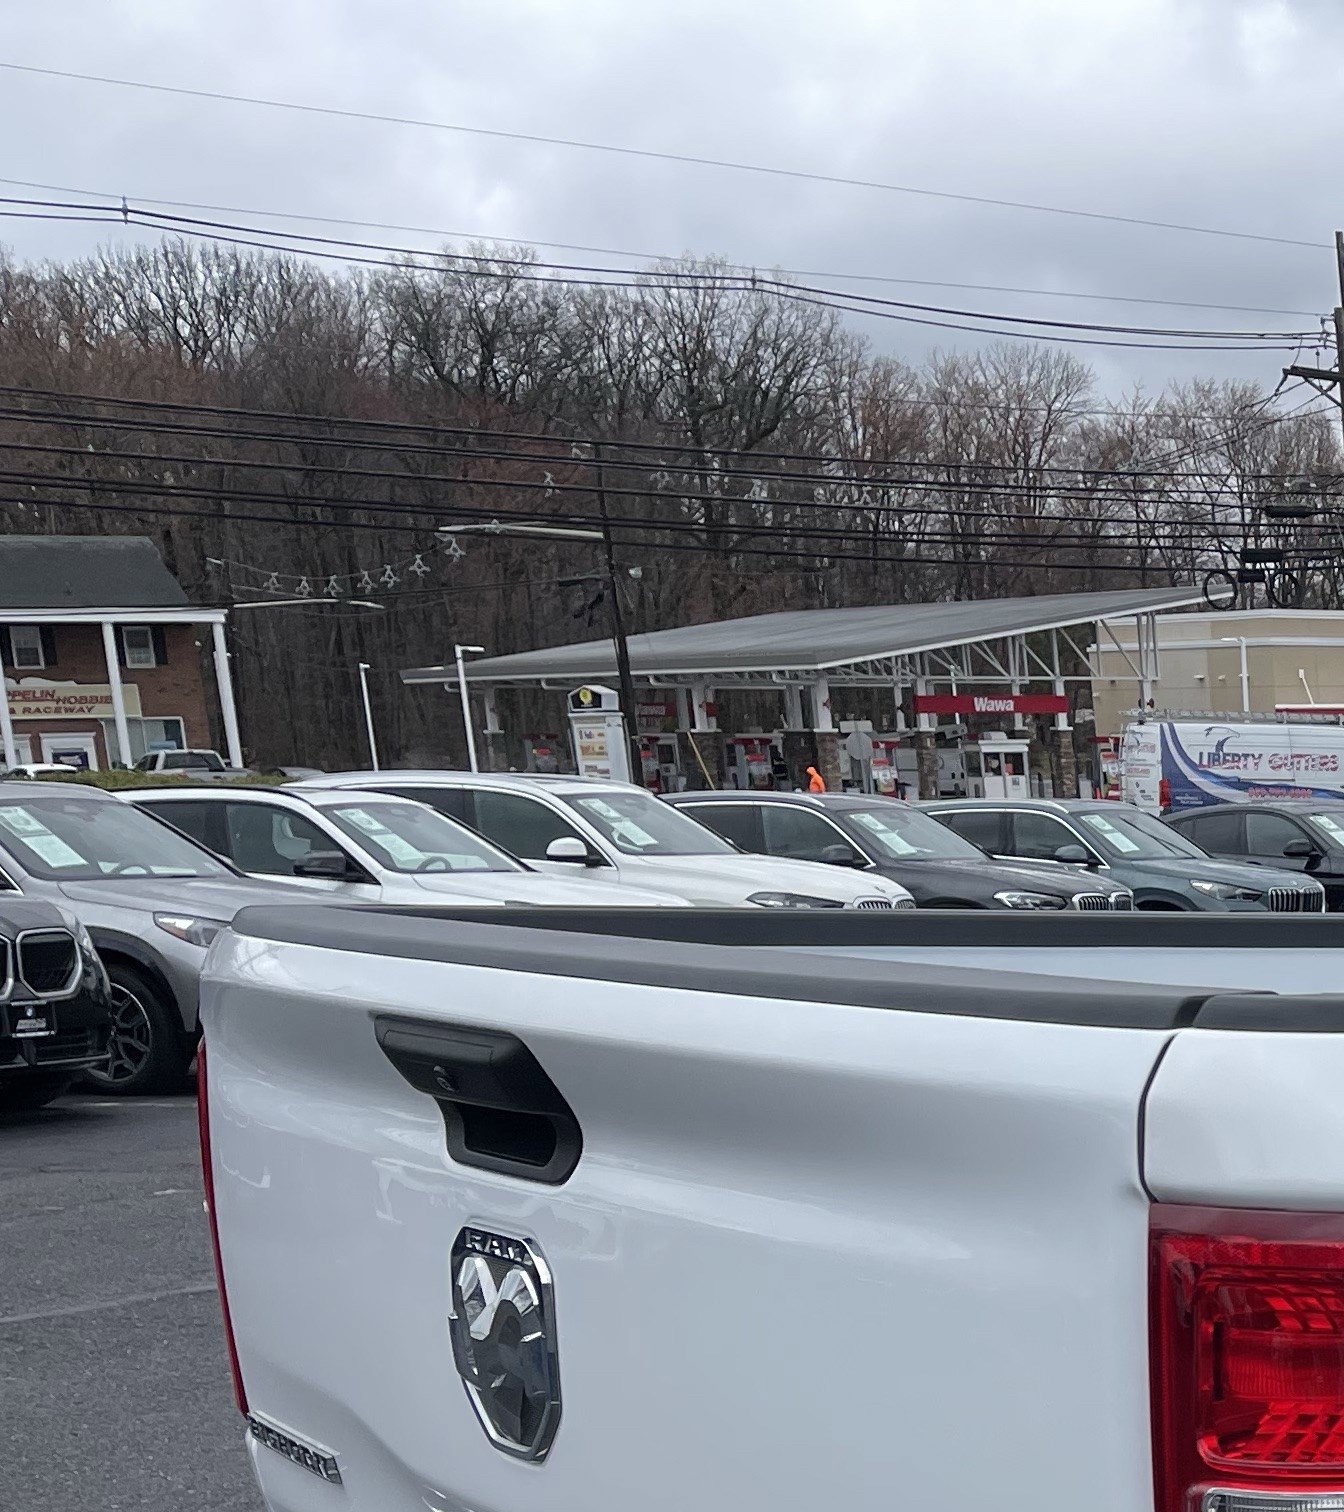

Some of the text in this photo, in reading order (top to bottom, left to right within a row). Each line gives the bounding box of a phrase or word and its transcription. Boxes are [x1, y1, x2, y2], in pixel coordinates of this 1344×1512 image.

[56, 695, 113, 705] HOBBIE
[974, 696, 1015, 713] Wawa
[22, 706, 96, 715] RACEWAY
[1198, 752, 1340, 772] LIBERTY GUTTERS
